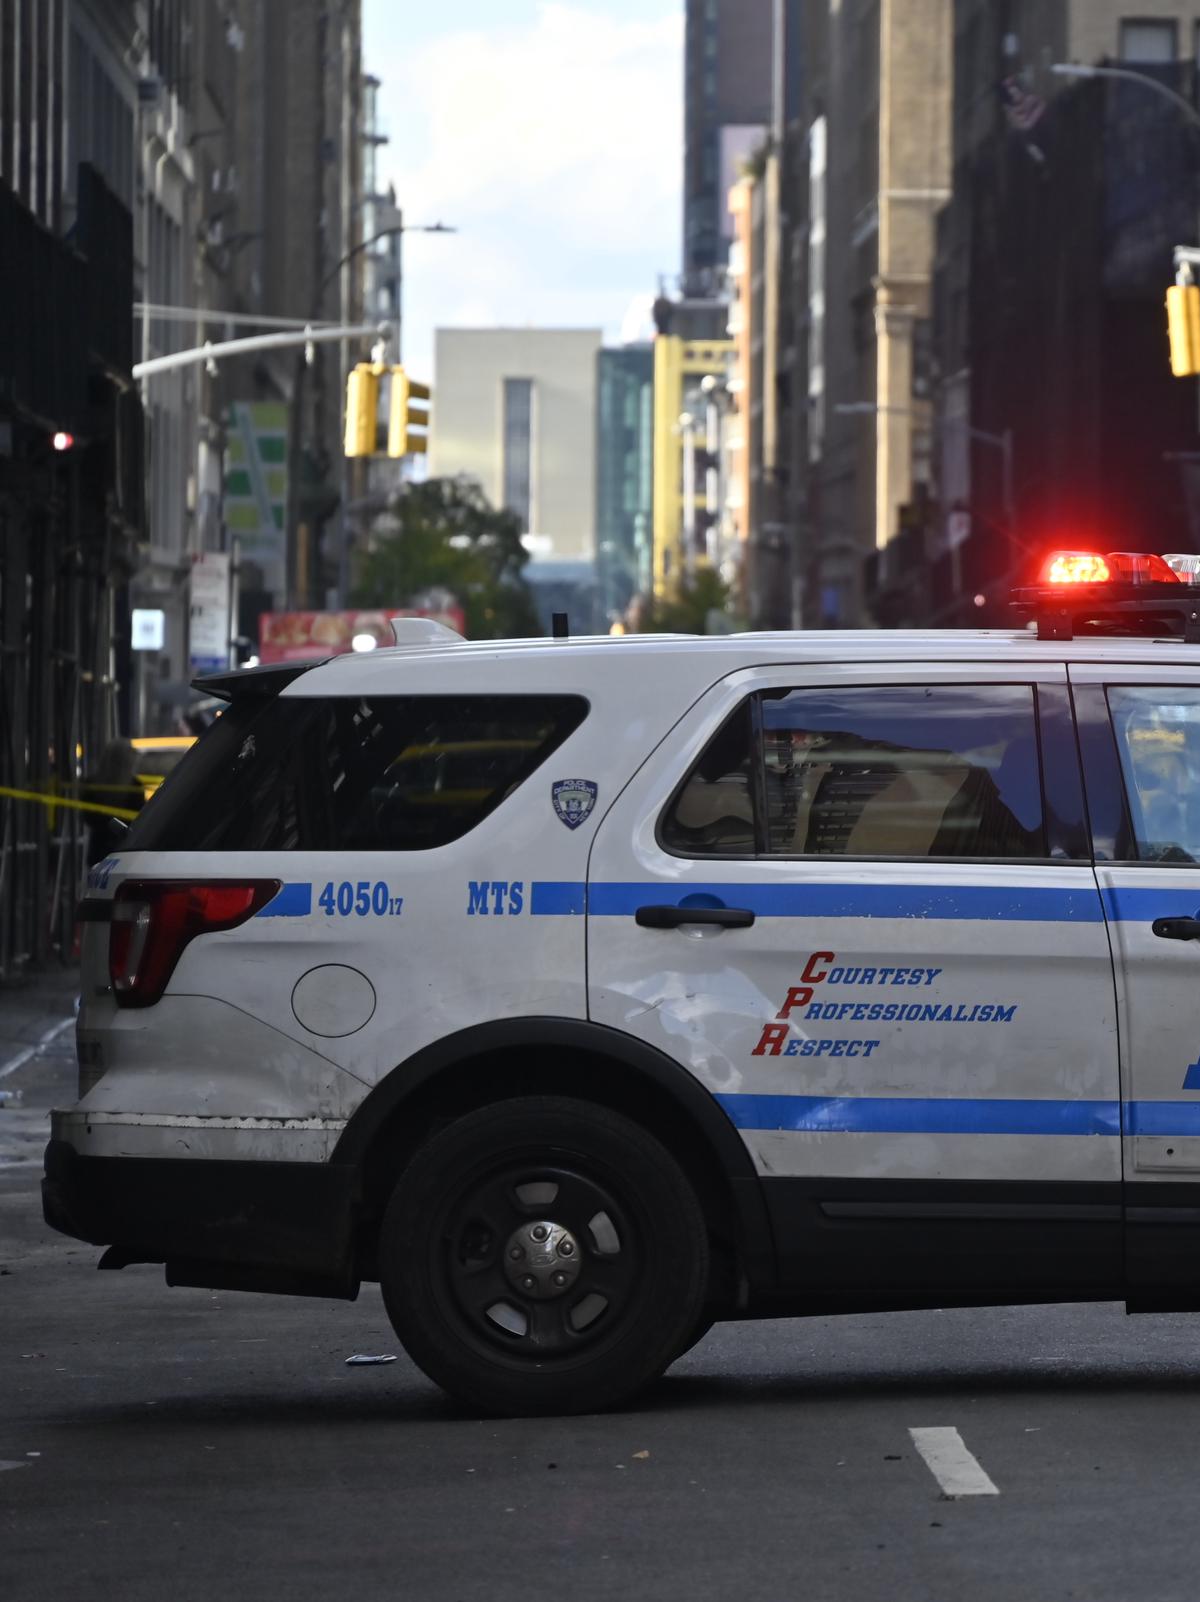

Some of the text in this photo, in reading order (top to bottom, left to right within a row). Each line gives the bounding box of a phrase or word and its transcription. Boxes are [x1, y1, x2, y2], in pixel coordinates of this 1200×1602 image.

[318, 880, 404, 916] 4050 17
[466, 880, 524, 916] MTS
[800, 951, 943, 985] COURTESY
[775, 986, 1018, 1023] PROFESSIONALISM
[751, 1023, 881, 1058] RESPECT
